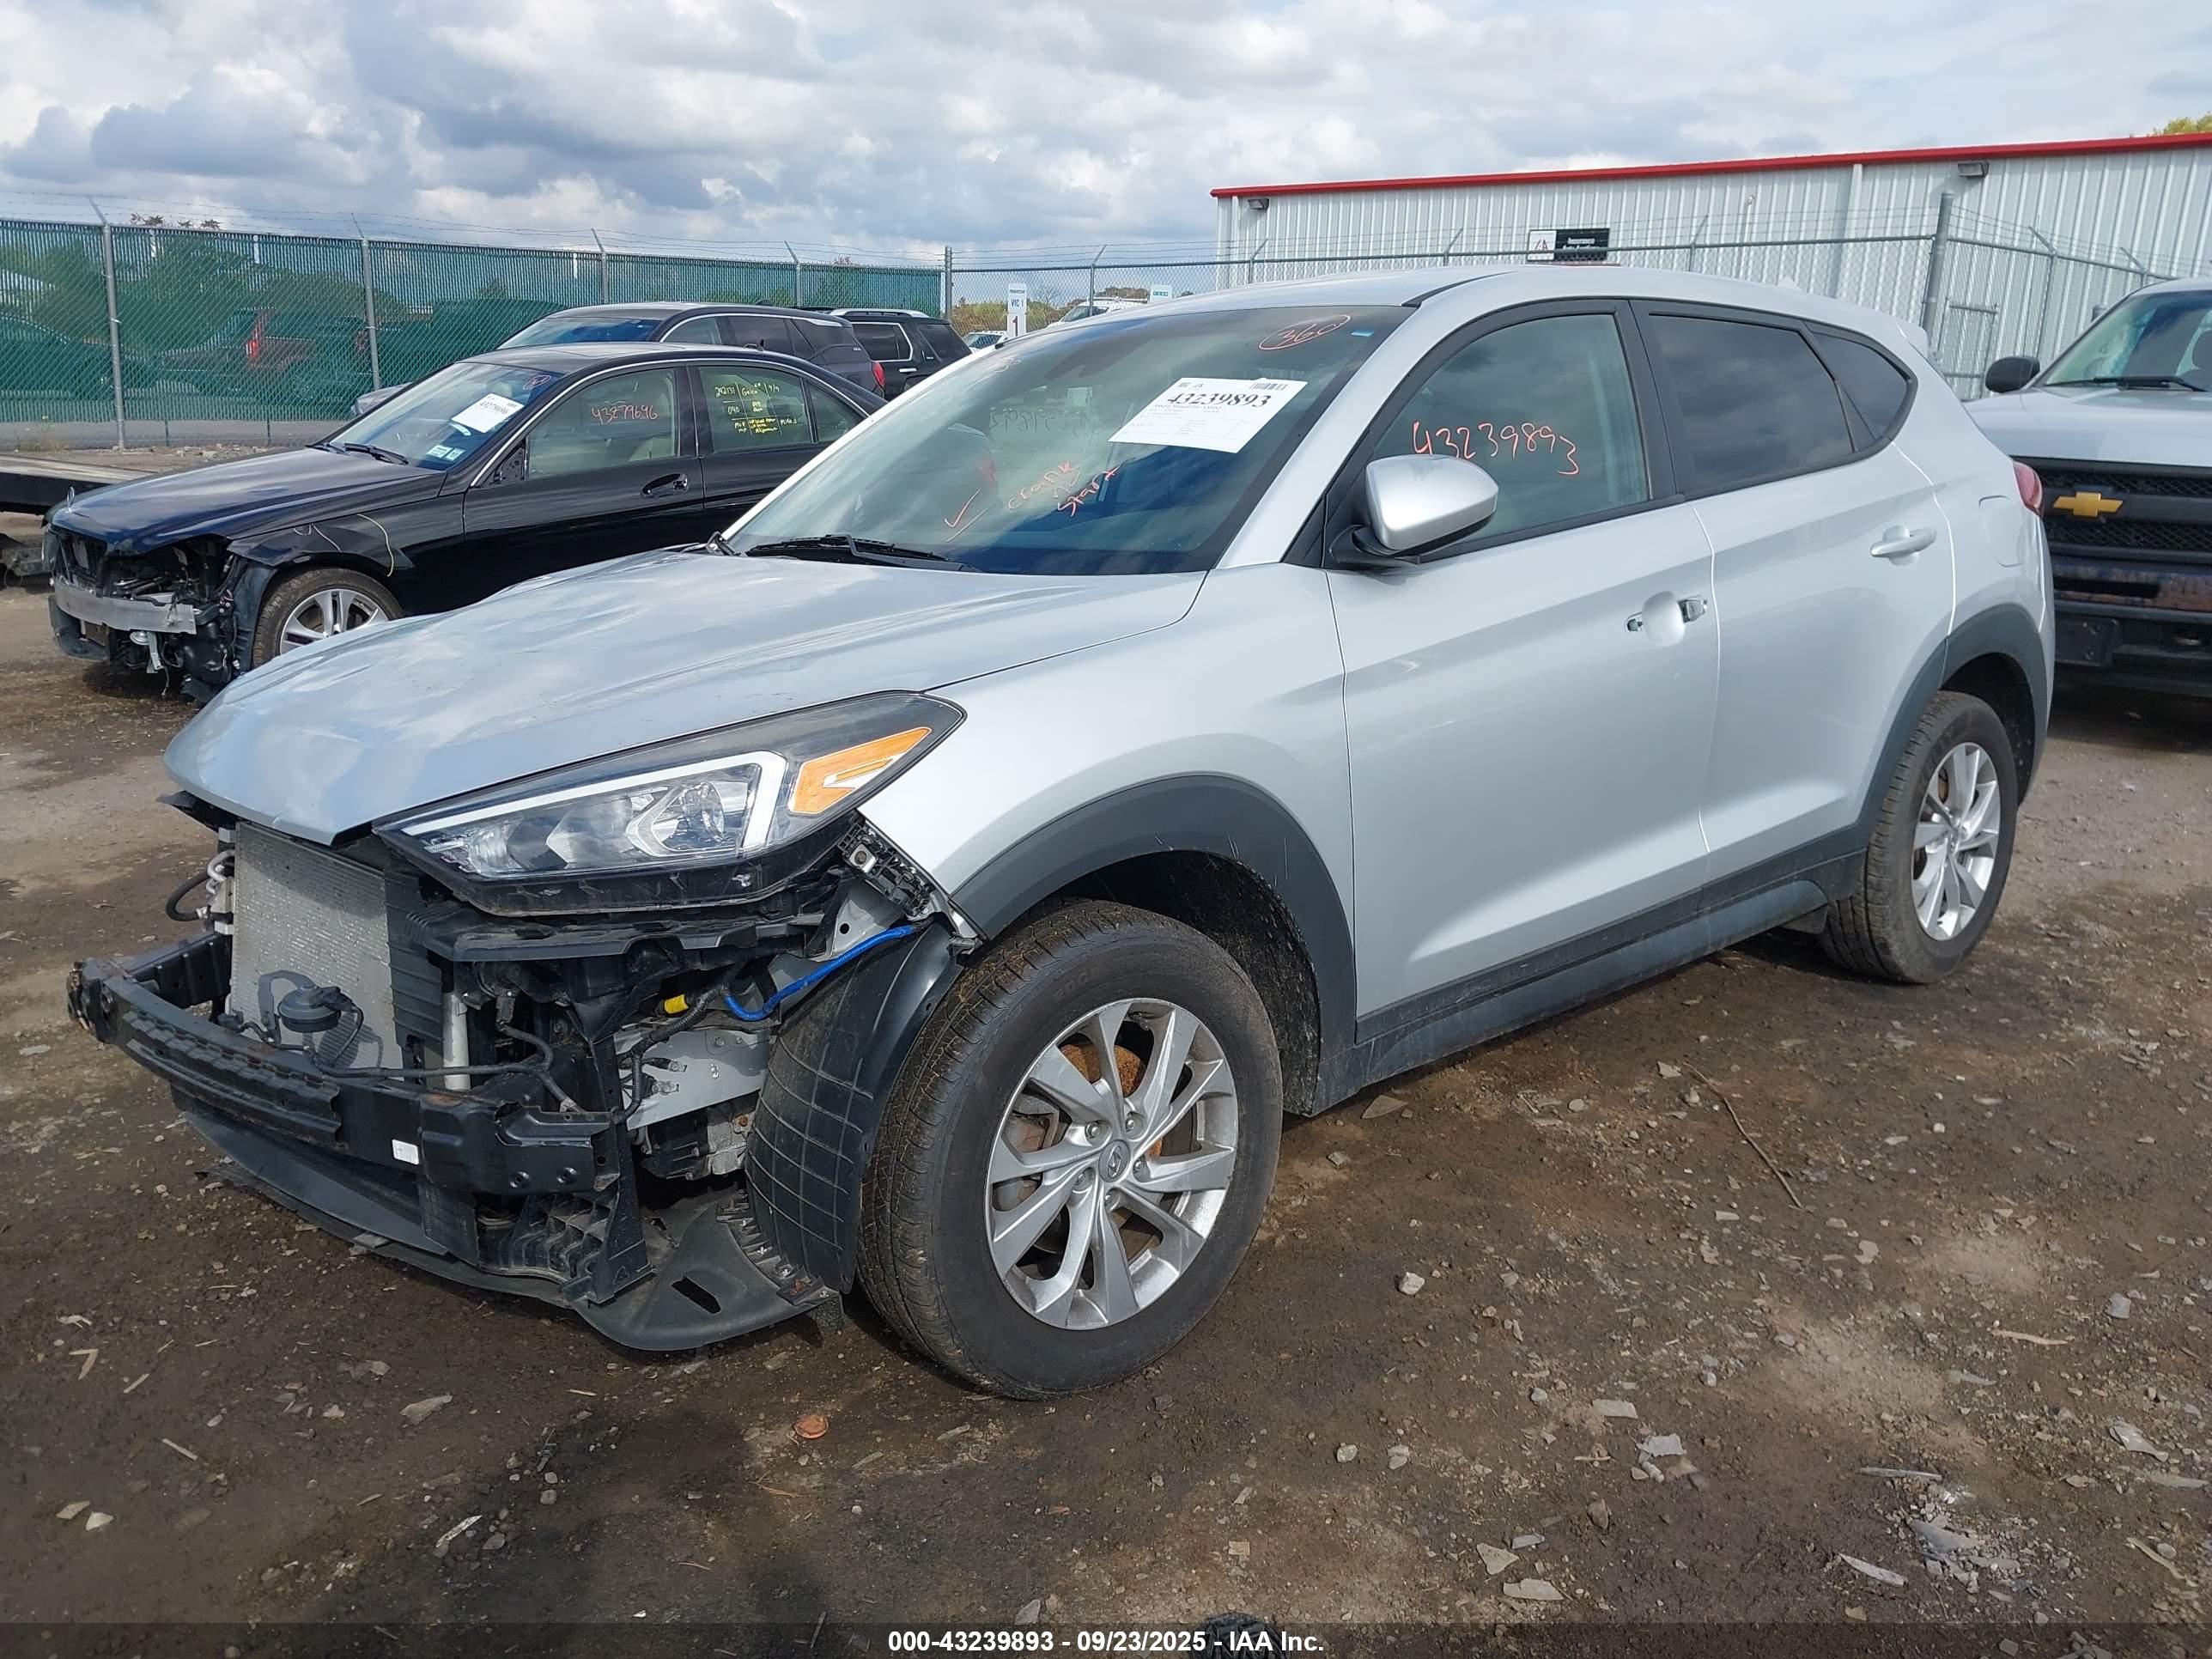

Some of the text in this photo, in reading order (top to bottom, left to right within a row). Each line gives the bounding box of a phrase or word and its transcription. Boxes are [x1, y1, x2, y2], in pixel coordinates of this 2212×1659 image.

[1012, 316, 1018, 337] 1
[1167, 392, 1272, 408] 43239893
[1413, 421, 1580, 476] 43239893
